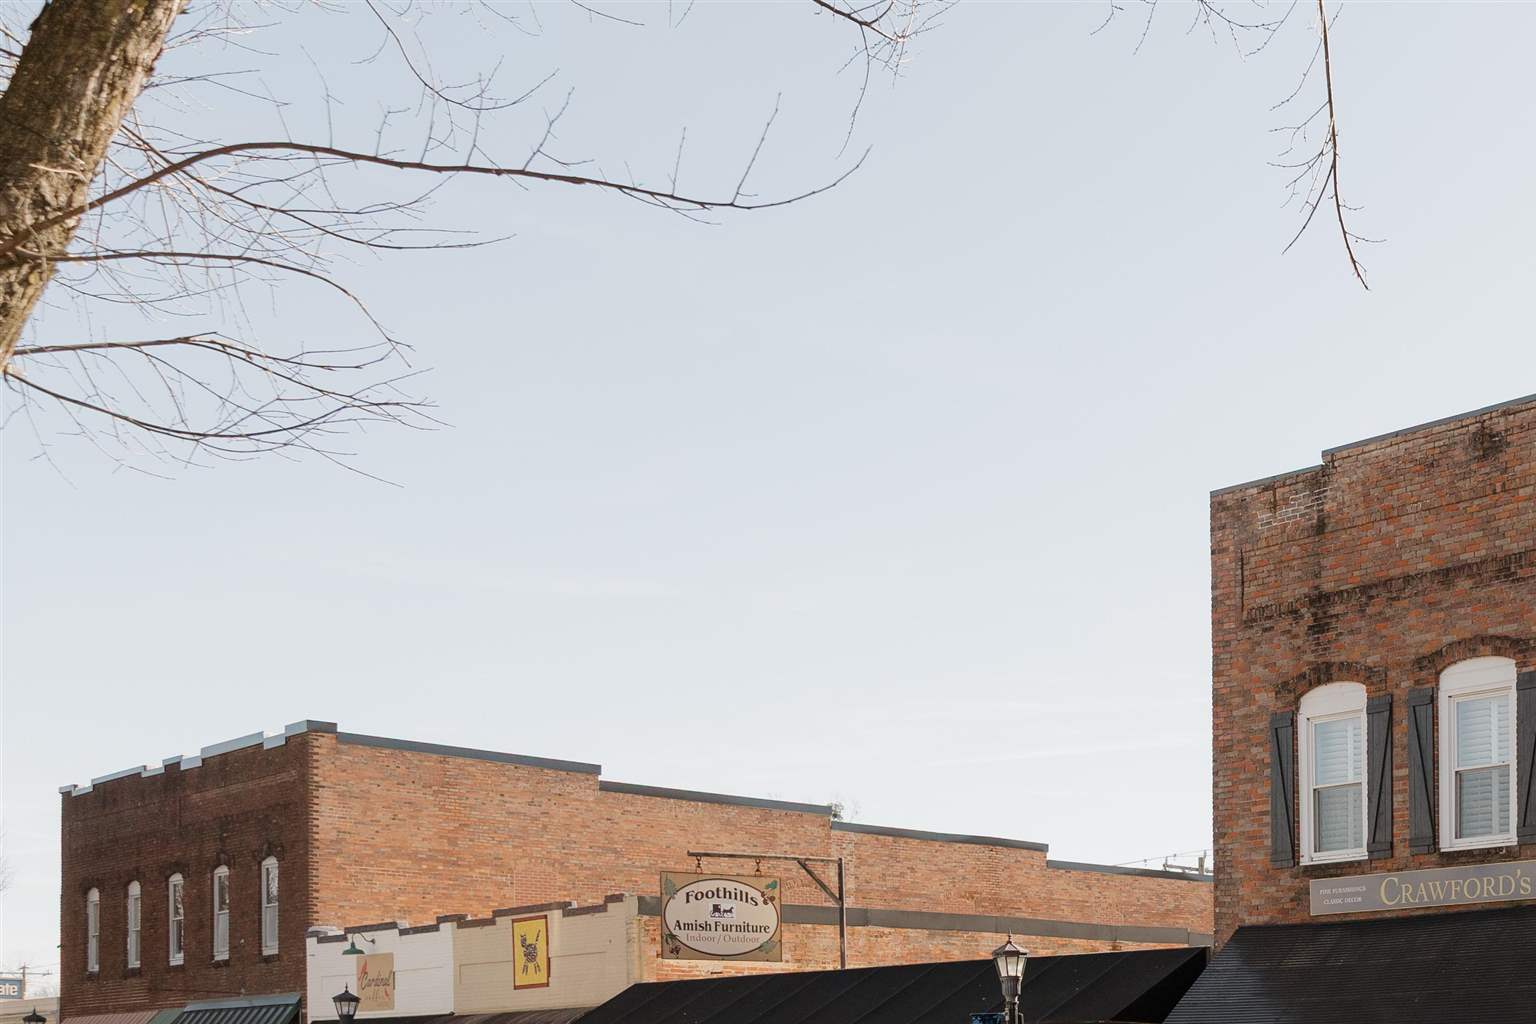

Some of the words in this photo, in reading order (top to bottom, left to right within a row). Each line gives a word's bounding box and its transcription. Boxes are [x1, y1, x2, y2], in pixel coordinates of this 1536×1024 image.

[1379, 868, 1532, 905] CRAWFORD'S
[685, 887, 759, 907] Foothills
[673, 920, 712, 932] Amish
[714, 921, 770, 933] Furniture
[686, 933, 715, 943] Indoor
[723, 934, 760, 944] Outdoor
